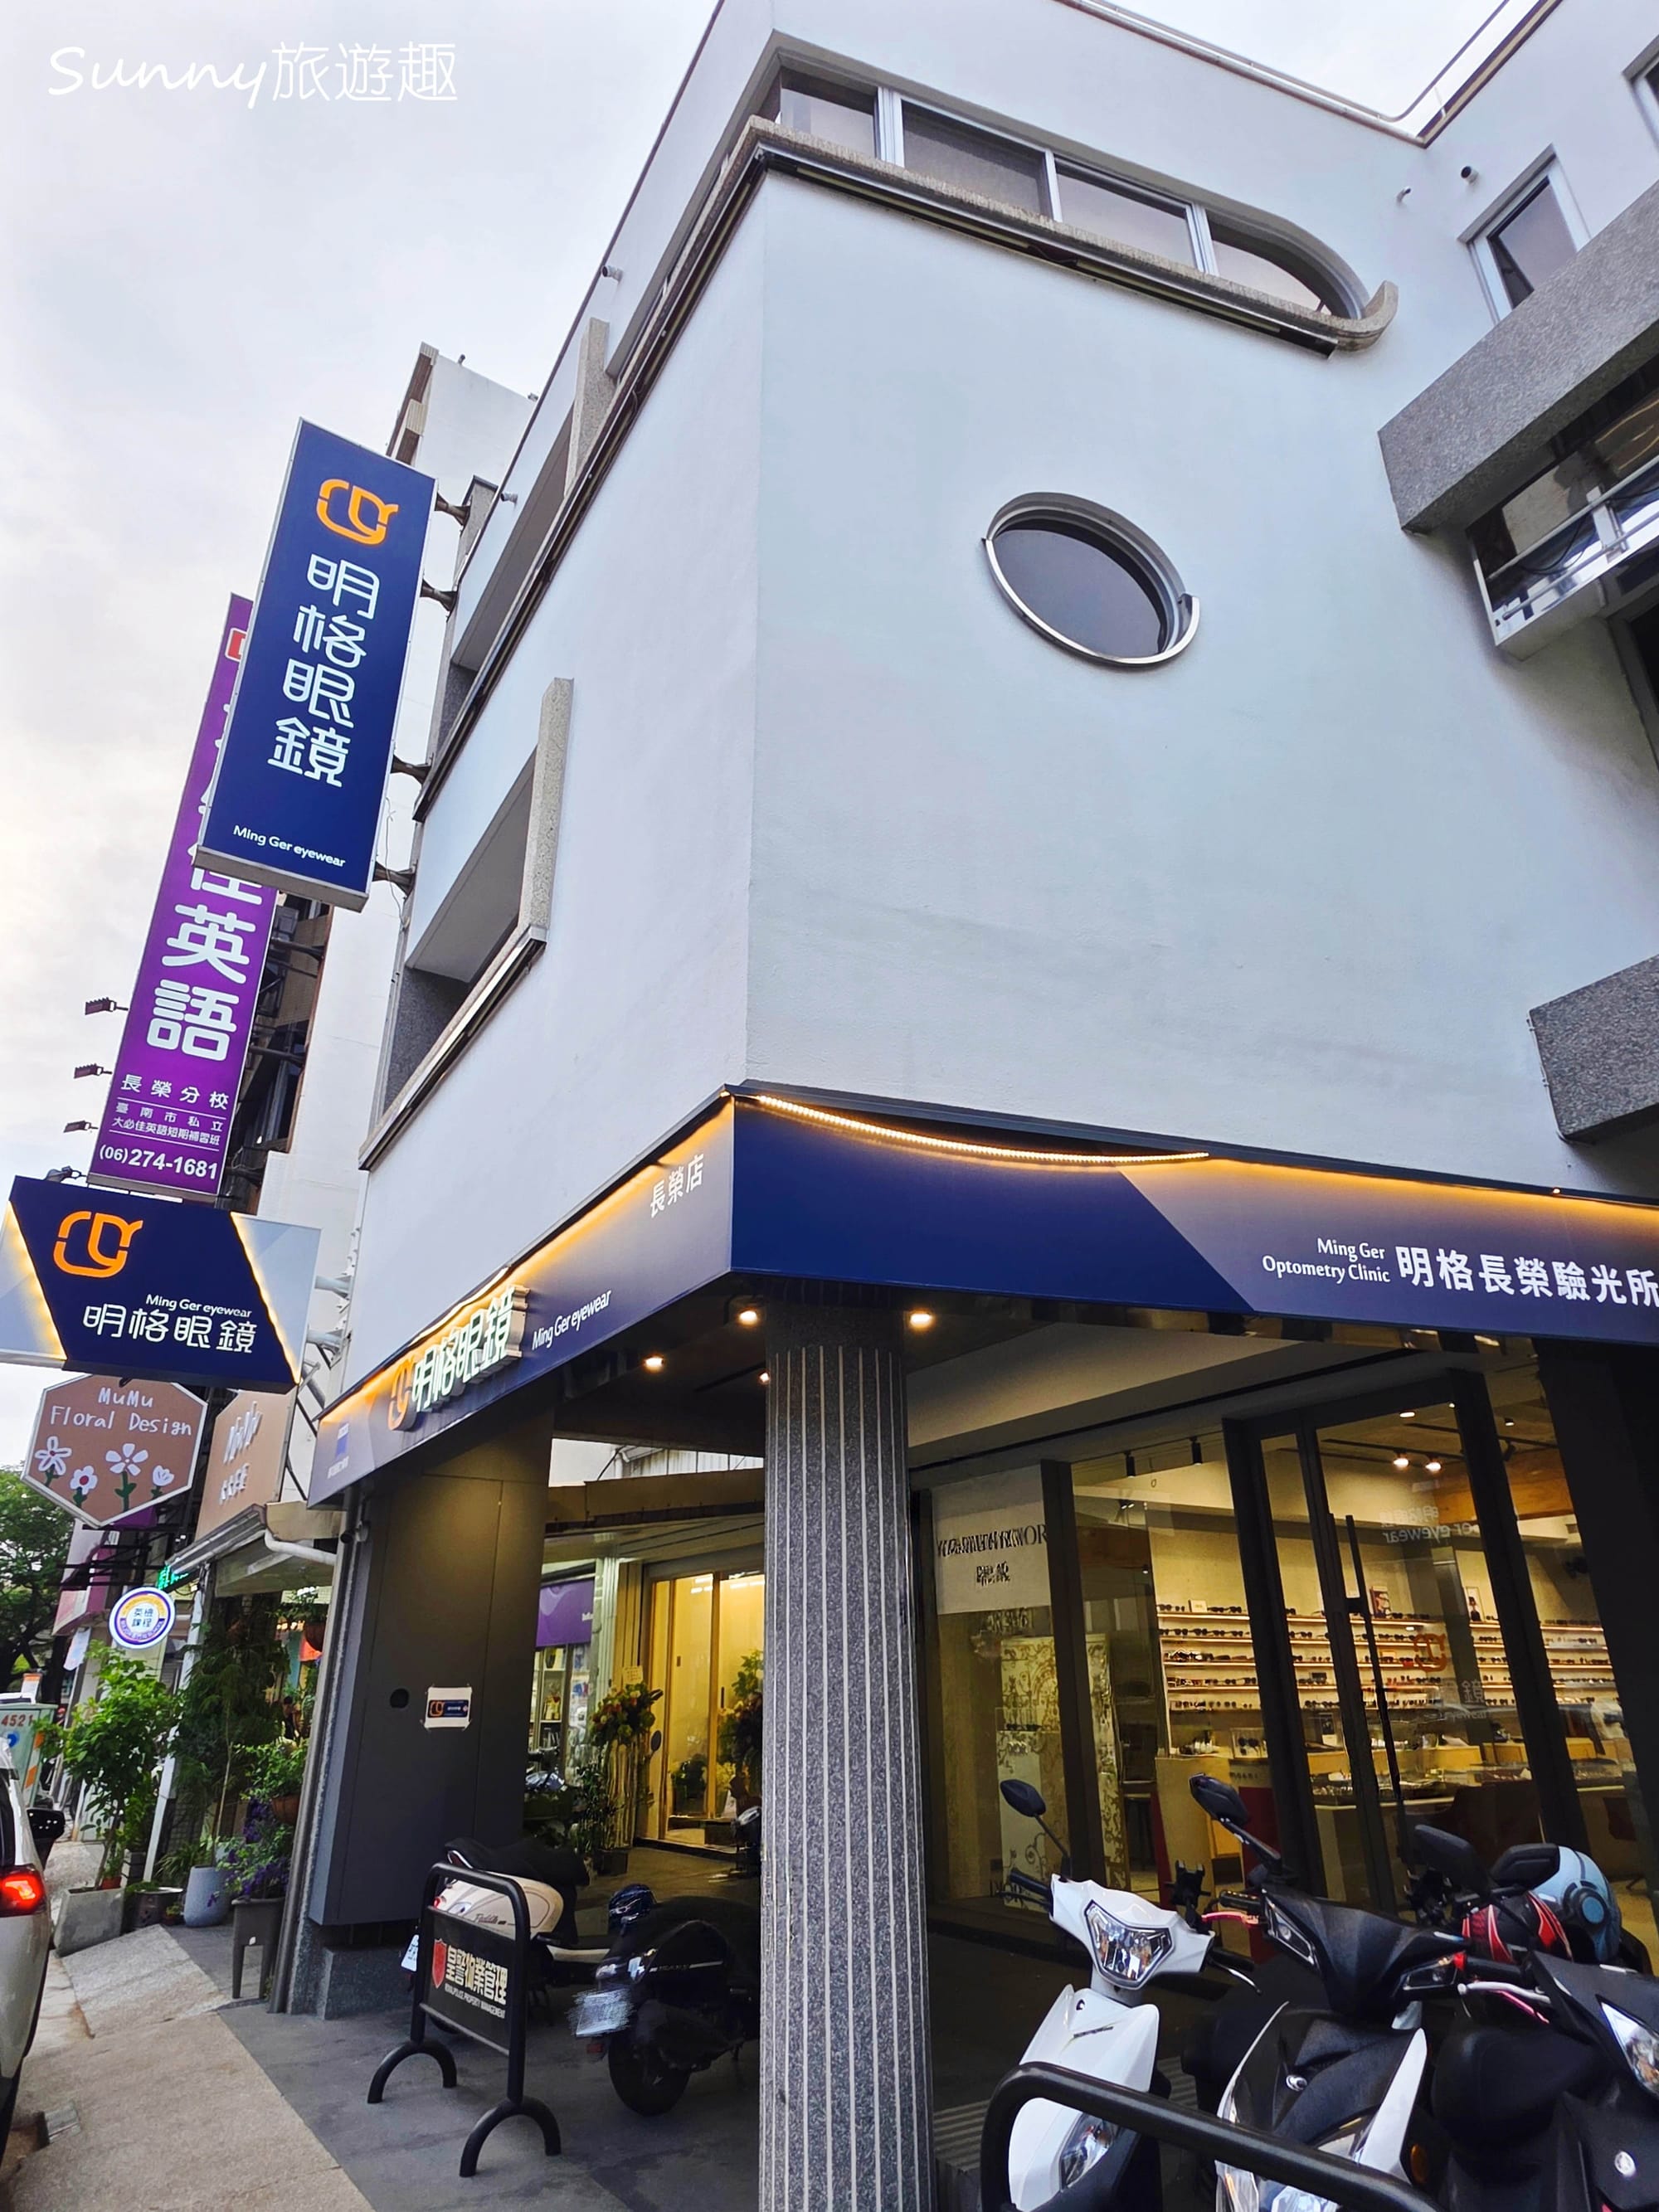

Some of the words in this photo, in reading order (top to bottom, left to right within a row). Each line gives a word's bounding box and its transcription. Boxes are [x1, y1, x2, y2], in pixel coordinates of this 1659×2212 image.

[268, 554, 380, 787] 明格眼鏡
[233, 825, 266, 846] Ming
[269, 836, 292, 851] Ger
[294, 846, 346, 867] eyewear
[120, 1074, 229, 1110] 長榮分校
[100, 1144, 218, 1179] (06)274-1681
[649, 1154, 703, 1218] 長榮店
[1317, 1237, 1358, 1262] Ming
[1359, 1242, 1384, 1259] Ger
[1262, 1255, 1345, 1284] Optometry
[1348, 1263, 1391, 1282] Clinic
[1395, 1246, 1659, 1308] 明格長榮驗光所
[145, 1294, 177, 1310] Ming
[179, 1299, 202, 1311] Ger
[202, 1305, 252, 1317] eyewear
[532, 1329, 553, 1349] Ming
[554, 1315, 572, 1336] Ger
[571, 1290, 611, 1331] eyewear
[83, 1303, 257, 1353] 明格眼鏡
[411, 1286, 516, 1412] 明格眼鏡
[98, 1388, 153, 1407] MuMu
[51, 1405, 115, 1429] Floral
[129, 1412, 192, 1436] Design
[1, 1714, 34, 1727] 4521
